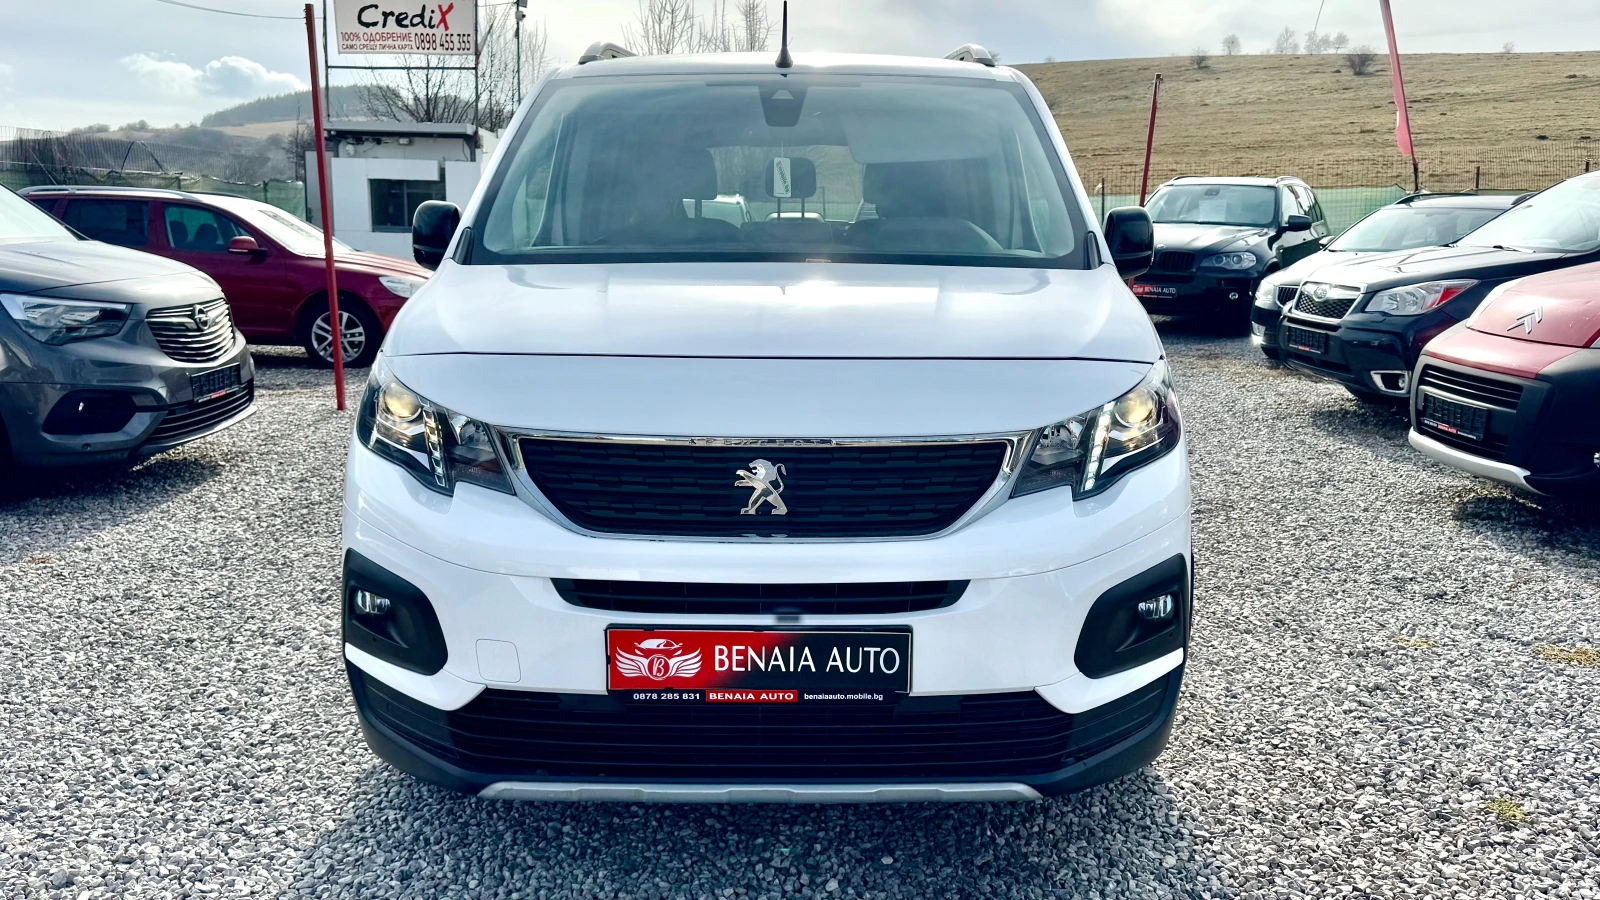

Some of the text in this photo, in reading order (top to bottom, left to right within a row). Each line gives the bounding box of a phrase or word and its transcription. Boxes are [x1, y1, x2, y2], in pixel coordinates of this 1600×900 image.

[357, 2, 454, 31] CrediX
[341, 32, 413, 43] 100% ОДОБРЕНИЕ
[414, 33, 471, 51] 0898 455 355
[341, 43, 358, 51] САМО
[397, 43, 414, 51] КАРТА
[714, 644, 901, 674] BENAIA AUTO
[633, 692, 700, 700] 0878 285 831
[709, 692, 794, 700] BENAIA AUTO
[804, 693, 884, 701] benaiaauto.mobile.bg
